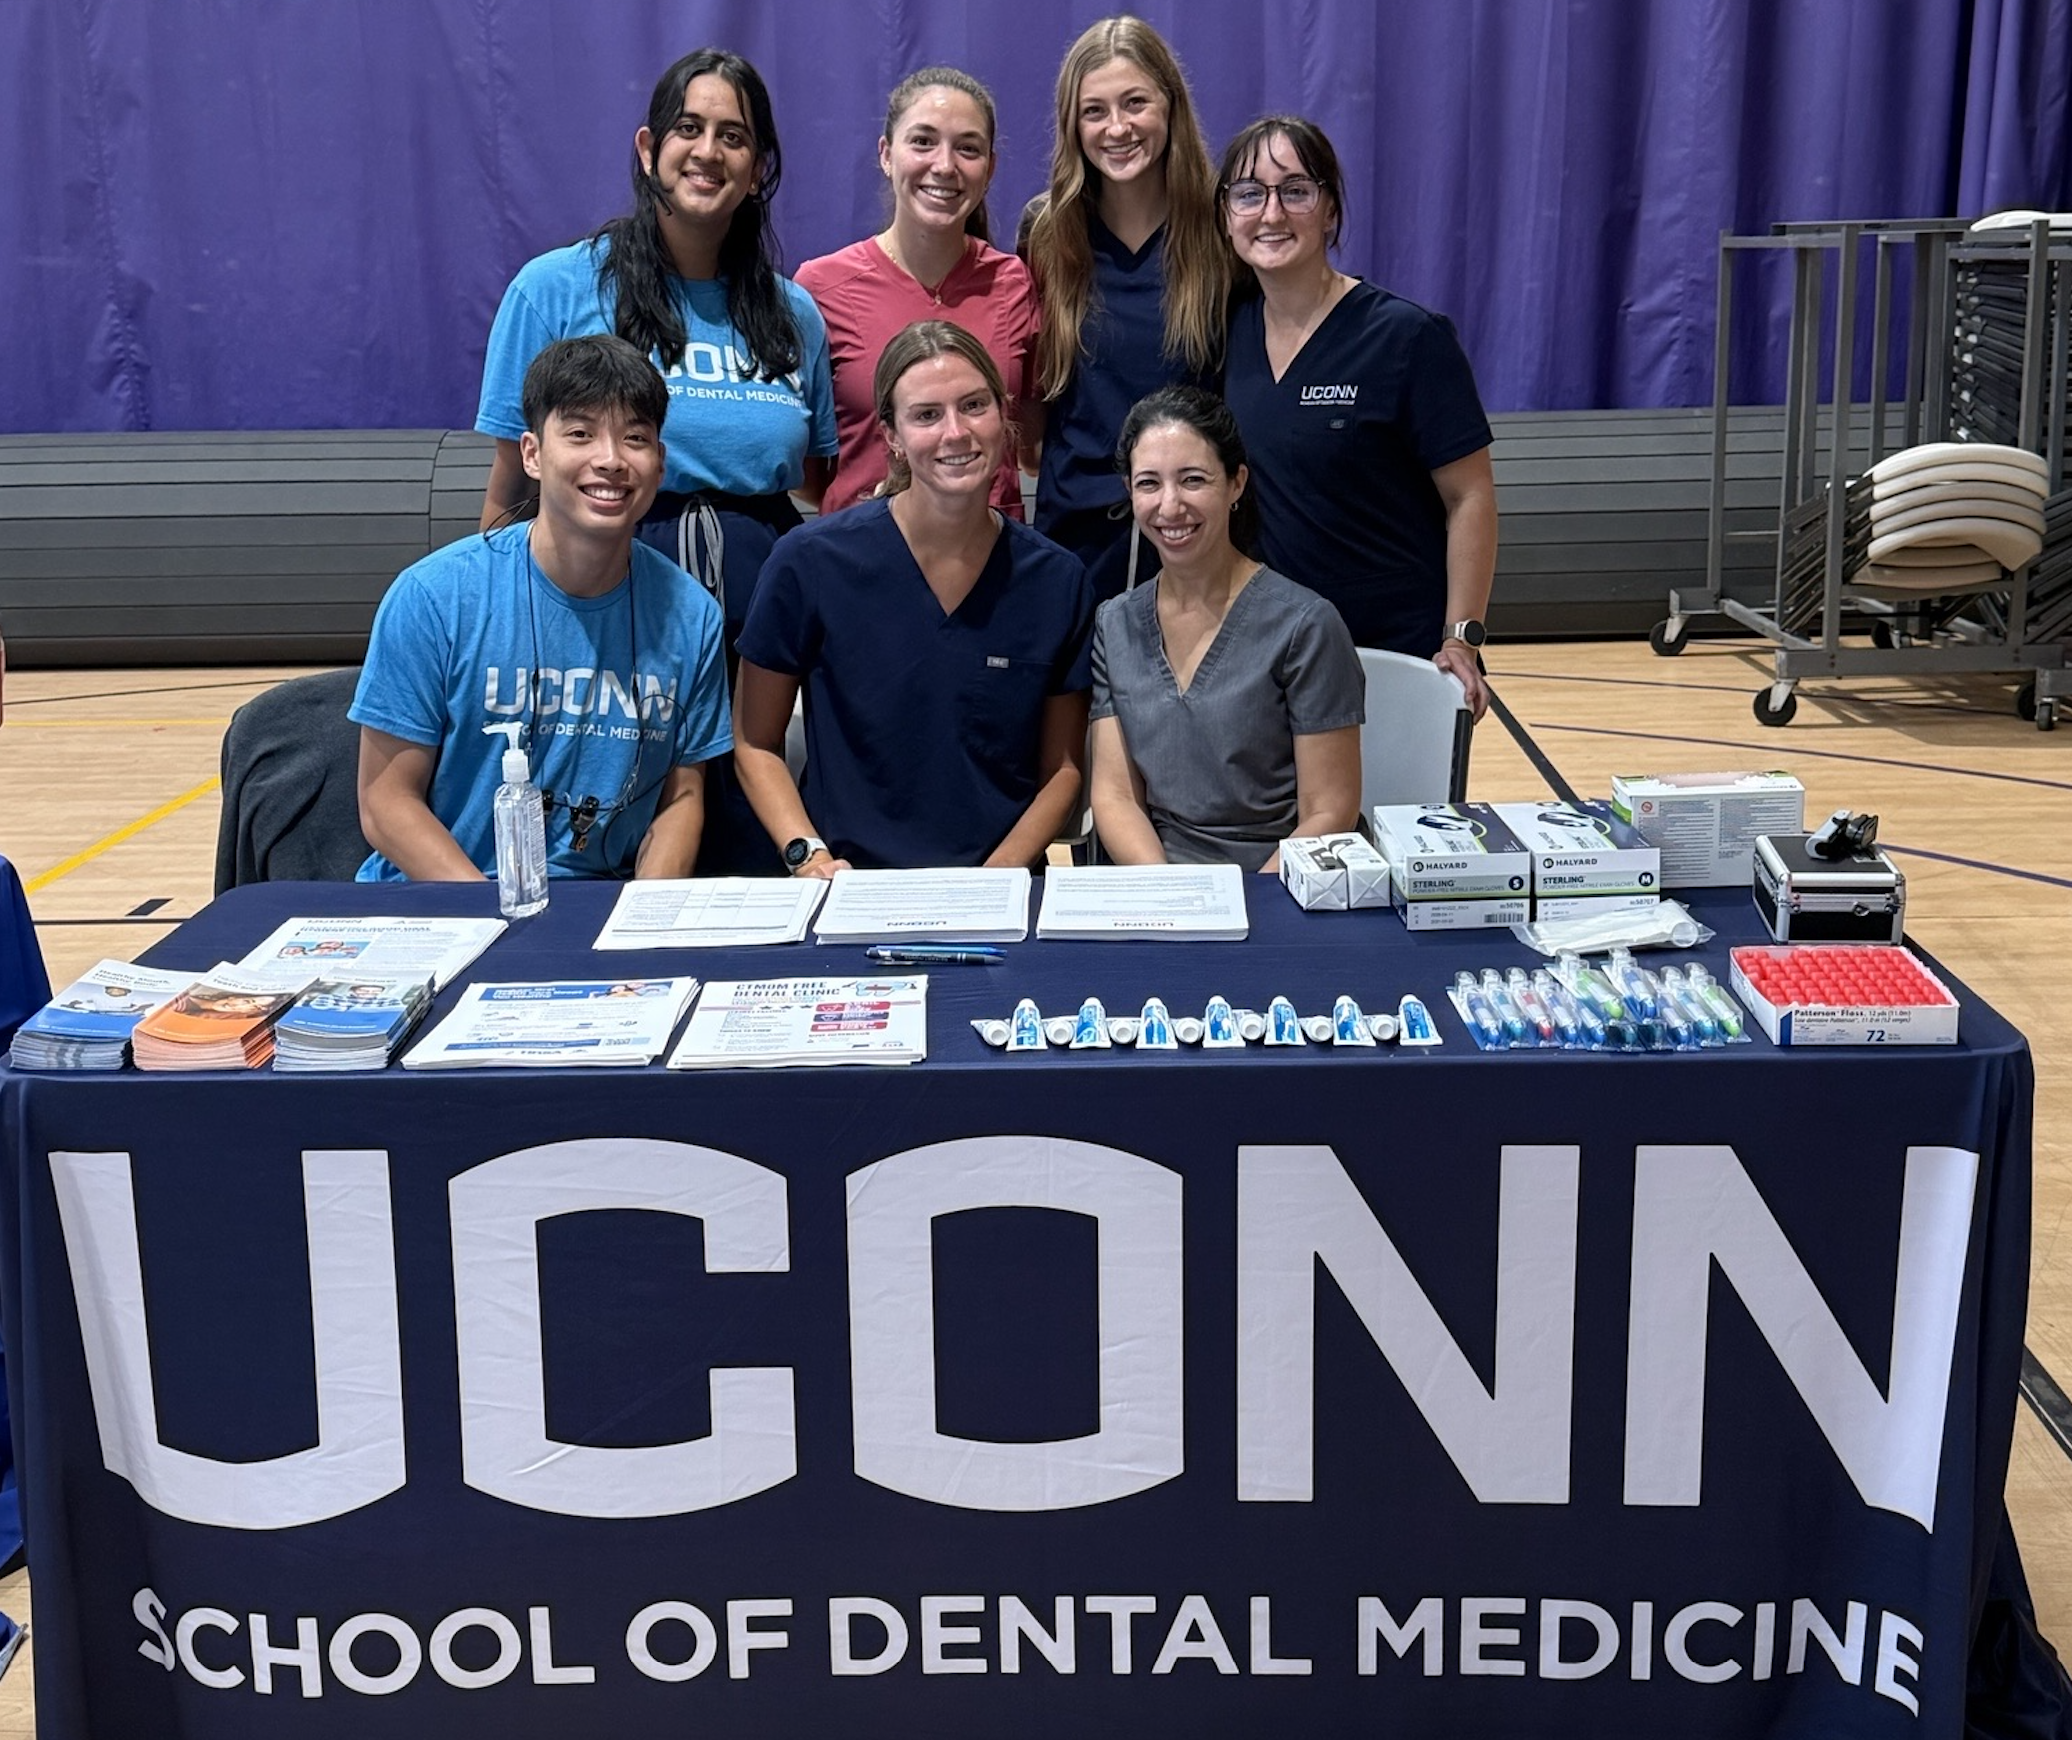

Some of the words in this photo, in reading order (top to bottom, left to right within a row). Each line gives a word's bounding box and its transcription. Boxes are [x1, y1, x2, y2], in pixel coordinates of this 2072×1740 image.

[666, 385, 684, 396] OF
[687, 387, 743, 401] DENTAL
[1301, 384, 1358, 400] UCONN
[484, 667, 677, 722] UCONN
[1426, 862, 1468, 870] HALYARD
[1556, 858, 1598, 866] HALYARD
[1413, 880, 1455, 888] STERLING
[1543, 876, 1585, 884] STERLING
[793, 981, 827, 989] FREE
[793, 988, 840, 997] CLINIC
[1866, 1029, 1886, 1042] 72
[48, 1136, 1979, 1534] UCONN
[133, 1589, 595, 1697] SCHOOL
[626, 1599, 792, 1681] OF
[829, 1596, 1312, 1675] DENTAL
[1358, 1597, 1923, 1717] MEDICINE
